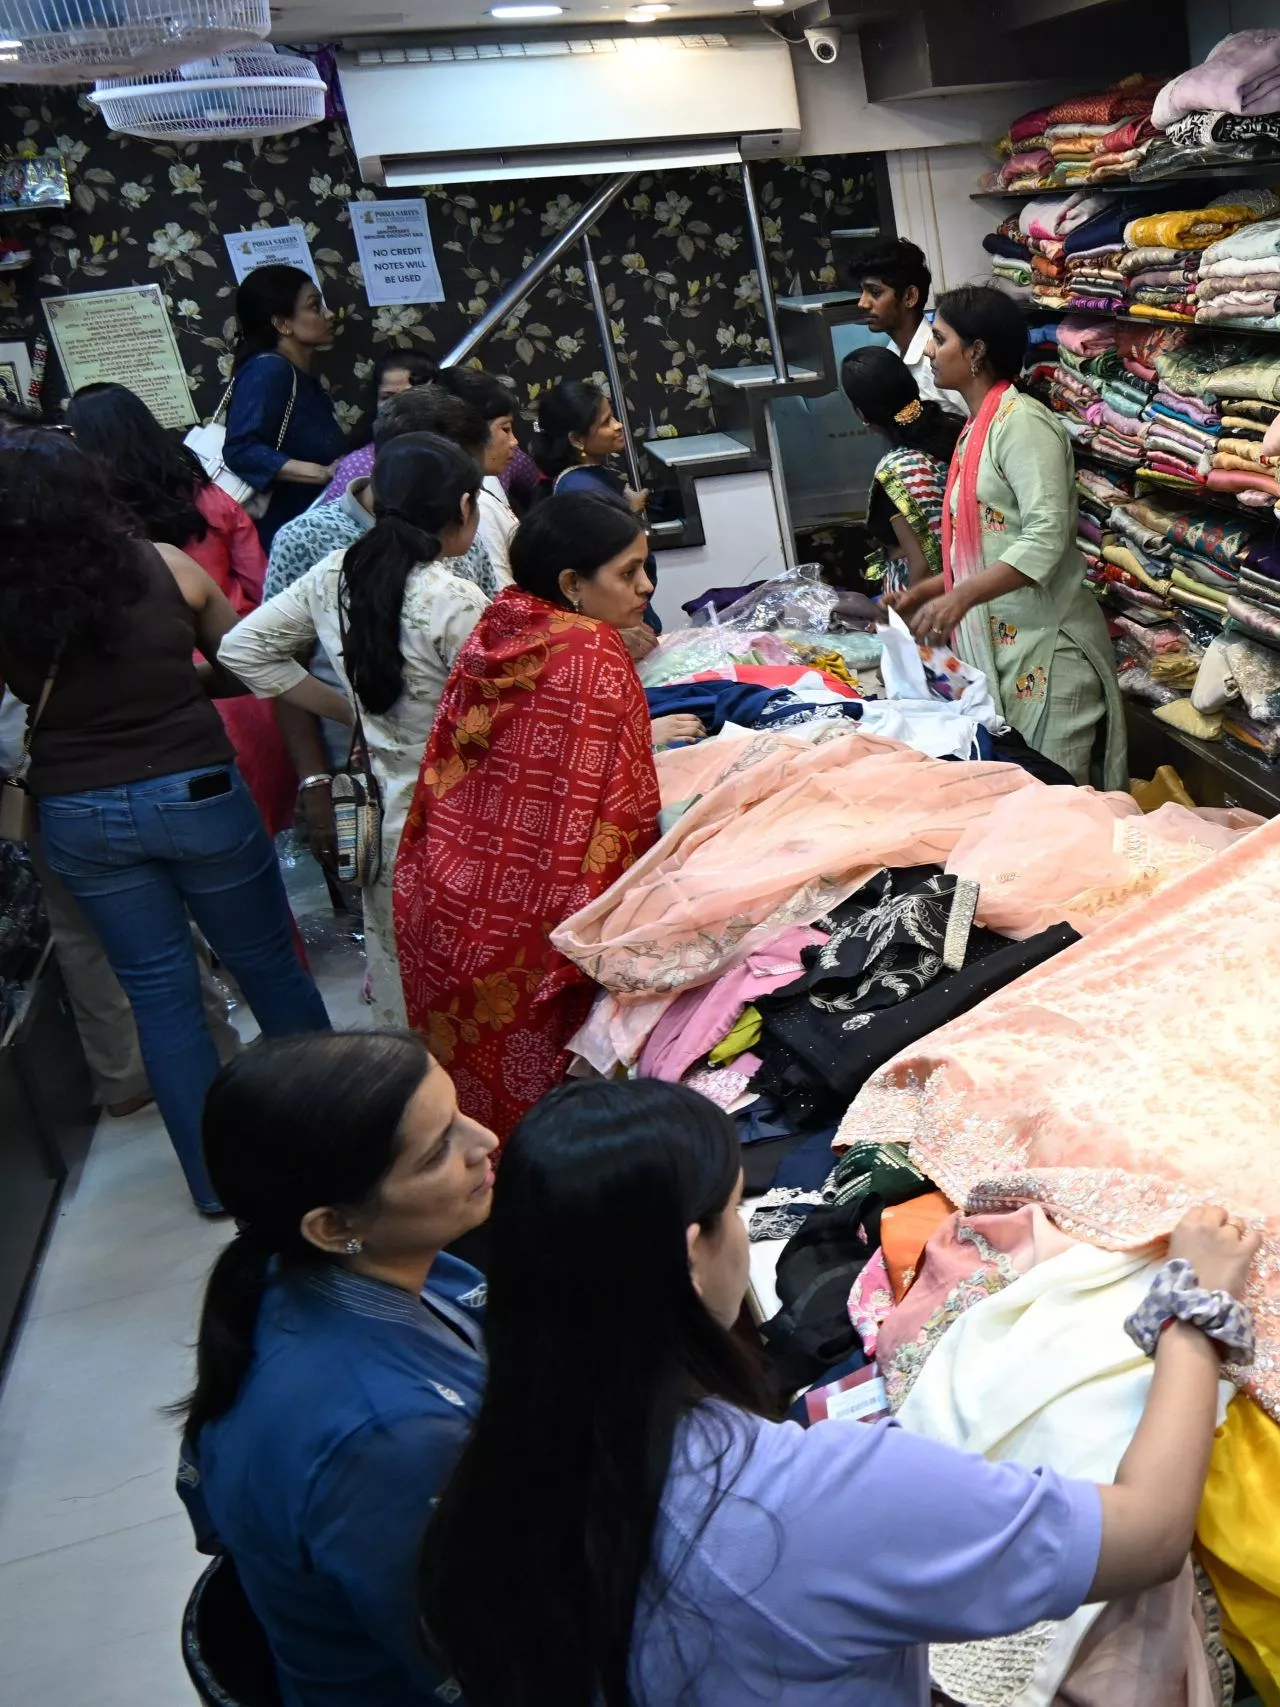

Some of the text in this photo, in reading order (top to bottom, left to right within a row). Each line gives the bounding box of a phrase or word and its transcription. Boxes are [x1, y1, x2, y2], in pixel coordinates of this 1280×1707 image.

[373, 247, 422, 257] NO CREDIT
[374, 260, 427, 271] NOTES WILL
[384, 274, 421, 284] BE USED
